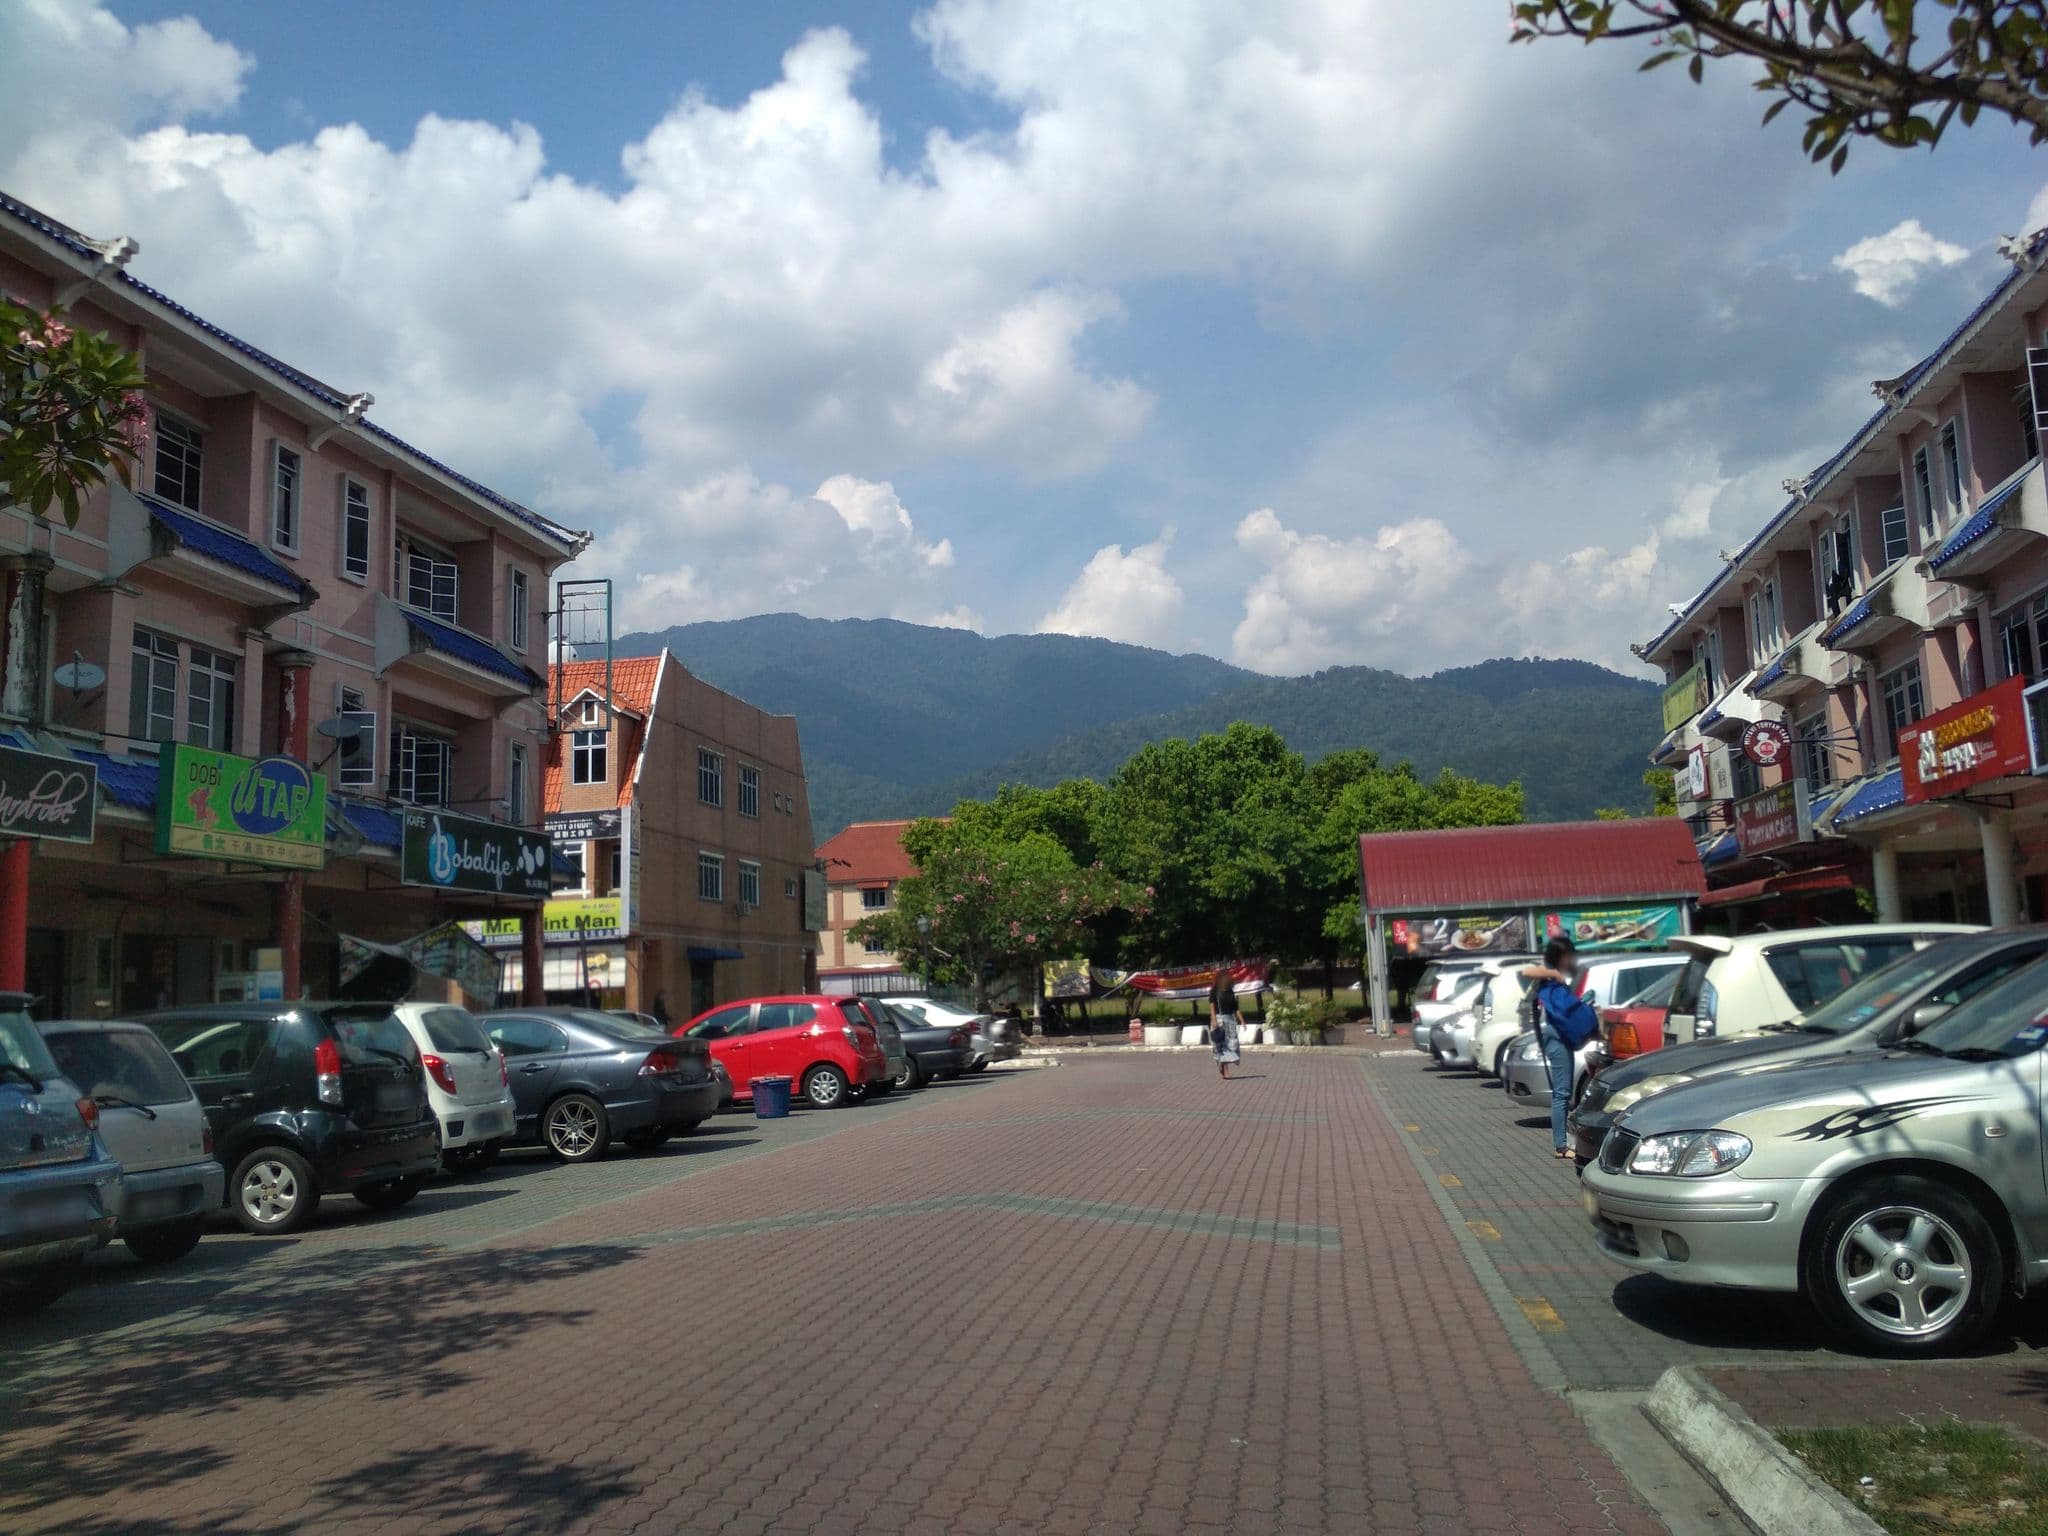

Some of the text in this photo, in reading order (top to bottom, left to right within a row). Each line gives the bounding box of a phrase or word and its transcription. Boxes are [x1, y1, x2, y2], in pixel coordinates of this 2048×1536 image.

[406, 814, 426, 829] KAFE
[433, 814, 514, 891] Bobalife
[486, 919, 515, 934] Mr.
[575, 914, 617, 929] Man
[1433, 917, 1449, 941] 2
